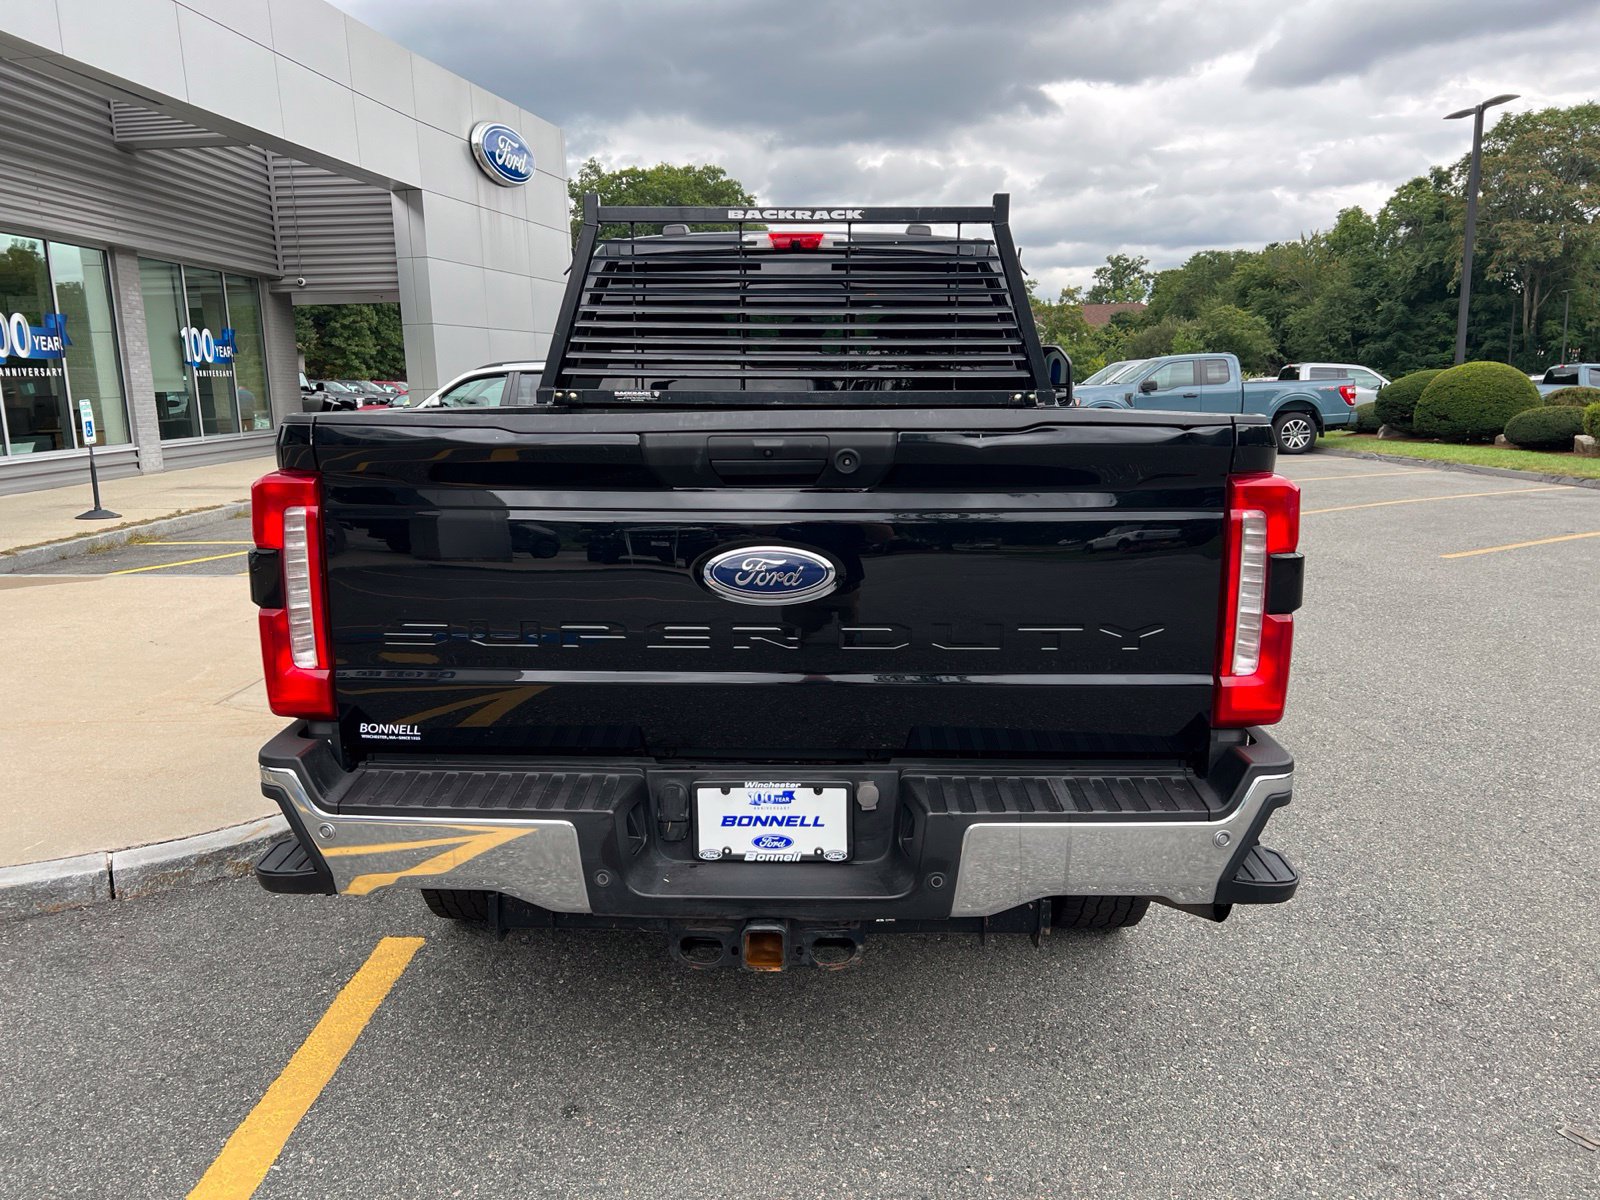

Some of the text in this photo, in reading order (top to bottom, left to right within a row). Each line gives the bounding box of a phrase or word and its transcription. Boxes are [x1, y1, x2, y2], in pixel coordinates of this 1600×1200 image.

[495, 135, 527, 174] Ford
[727, 209, 863, 220] BACKRACK
[32, 335, 64, 351] YEAR
[180, 326, 234, 363] 100 YEAR
[195, 369, 233, 378] ANNIVERSARY
[734, 557, 804, 587] Ford
[383, 620, 1166, 651] SUPER DUTY
[360, 723, 421, 735] BONNELL
[748, 791, 775, 805] 100
[721, 816, 825, 827] BONNELL
[758, 836, 787, 848] Ford
[744, 851, 801, 861] Bonnell
